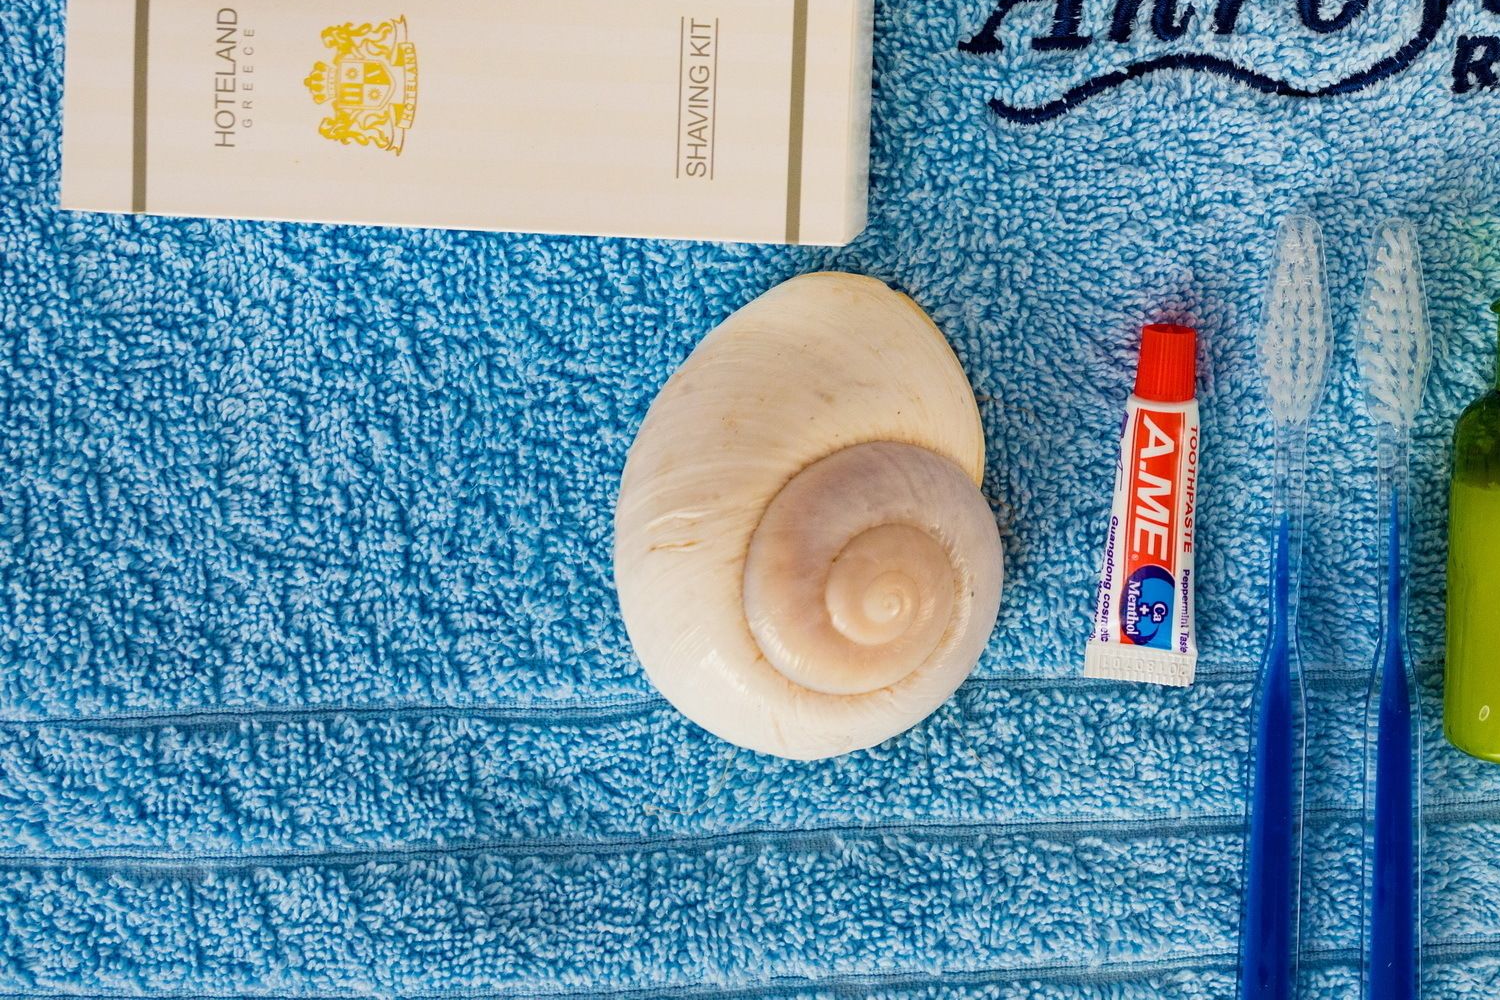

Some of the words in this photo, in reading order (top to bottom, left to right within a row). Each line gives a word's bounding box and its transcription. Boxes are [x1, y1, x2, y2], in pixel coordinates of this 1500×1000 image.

[690, 17, 711, 57] KIT
[214, 7, 238, 147] HOTELAND
[242, 28, 255, 128] GREECE
[403, 48, 417, 121] HOTELAND
[686, 65, 710, 178] SHAVING
[1133, 413, 1175, 561] A.ME
[1183, 425, 1198, 554] TOOTHPASTE
[1102, 515, 1119, 590] Guangdong
[1126, 580, 1141, 635] Menthol
[1153, 603, 1166, 622] Ca
[1180, 569, 1190, 628] Peppermint
